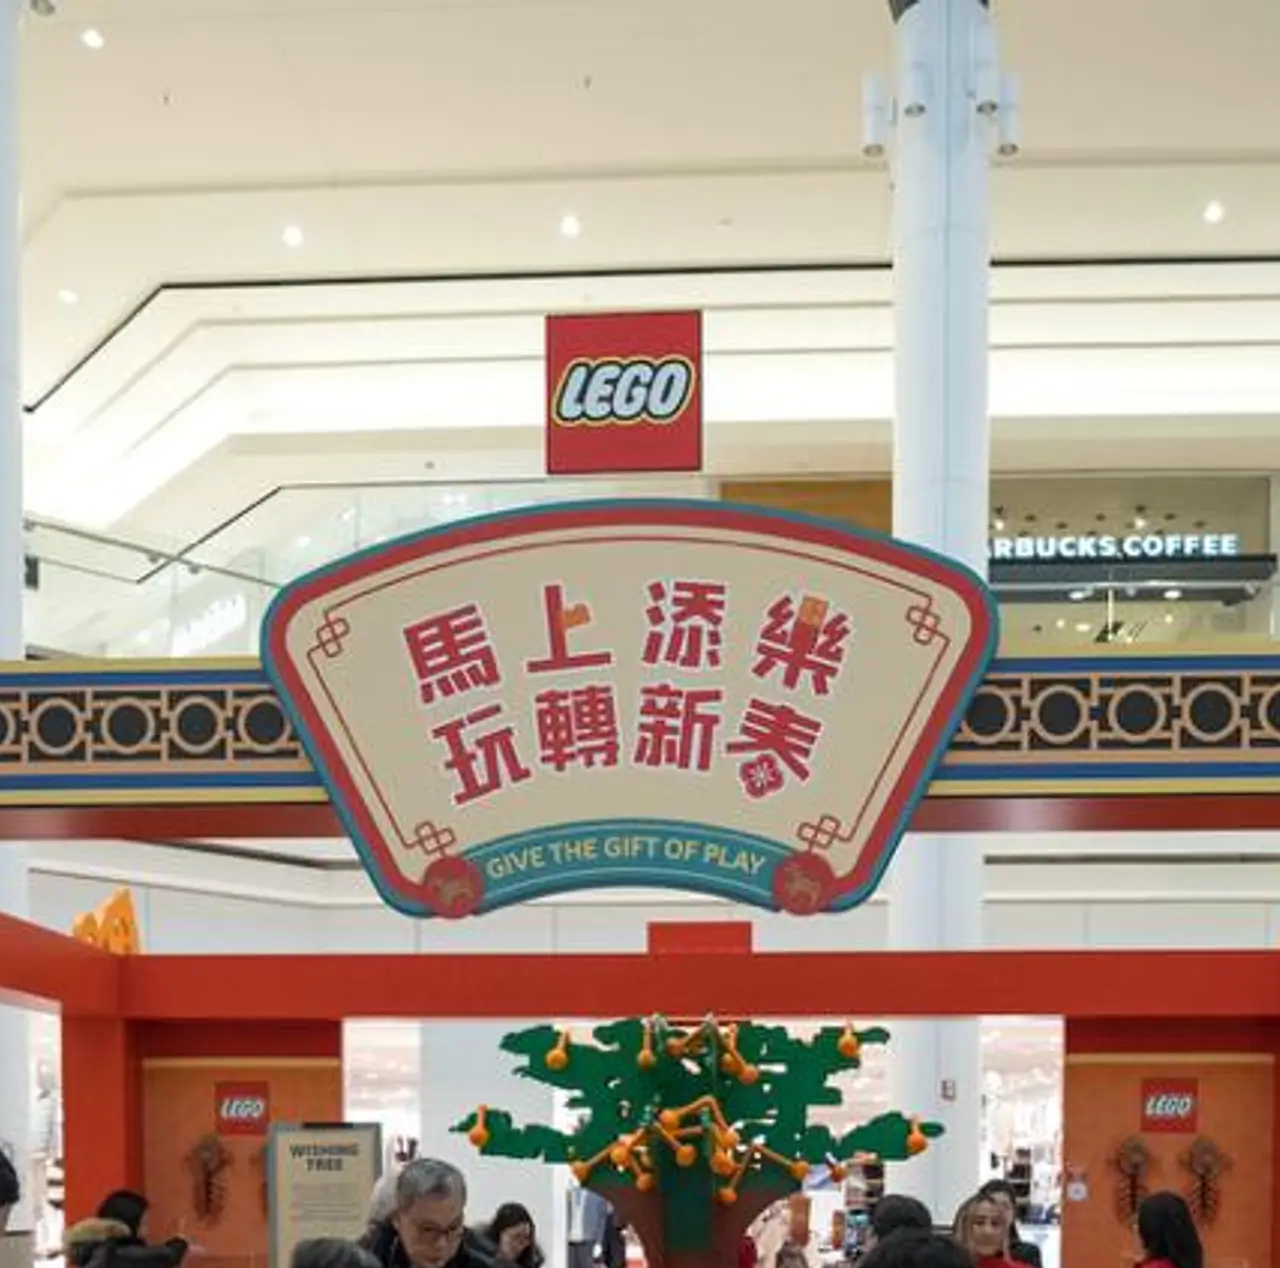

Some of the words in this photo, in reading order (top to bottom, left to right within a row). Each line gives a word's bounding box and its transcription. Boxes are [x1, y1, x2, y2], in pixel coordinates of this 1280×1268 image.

[555, 359, 692, 421] LEGO
[988, 536, 1115, 558] RBUCKS
[1123, 534, 1238, 556] COFFEE
[402, 581, 852, 701] 馬上添樂
[431, 685, 822, 805] 玩轉新春
[486, 842, 544, 881] GIVE
[548, 836, 597, 868] THE
[603, 834, 658, 863] GIFT
[665, 837, 698, 865] OF
[704, 841, 766, 876] PLAY
[219, 1098, 264, 1120] LEGO
[1144, 1096, 1192, 1118] LEGO
